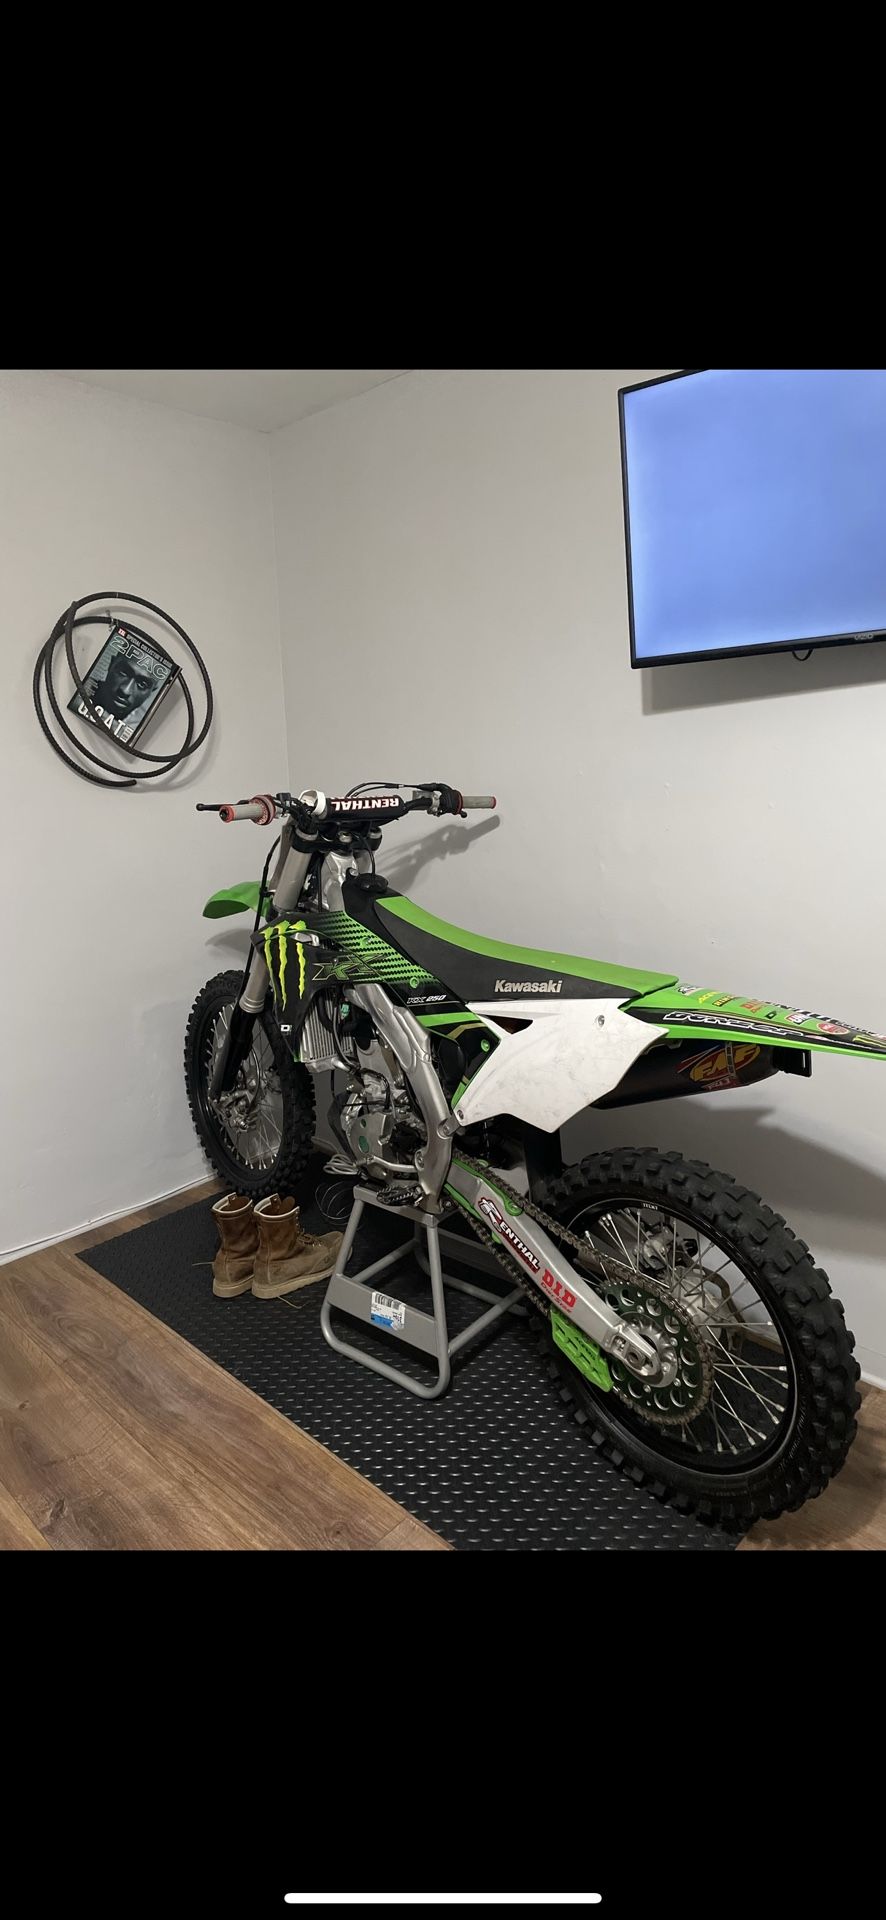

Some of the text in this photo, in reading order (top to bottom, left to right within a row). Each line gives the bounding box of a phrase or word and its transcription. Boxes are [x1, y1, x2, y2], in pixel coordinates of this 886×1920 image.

[109, 636, 168, 680] 2PAC
[331, 797, 399, 811] RENTHAL
[494, 978, 563, 994] Kawasaki
[426, 994, 447, 1002] 250
